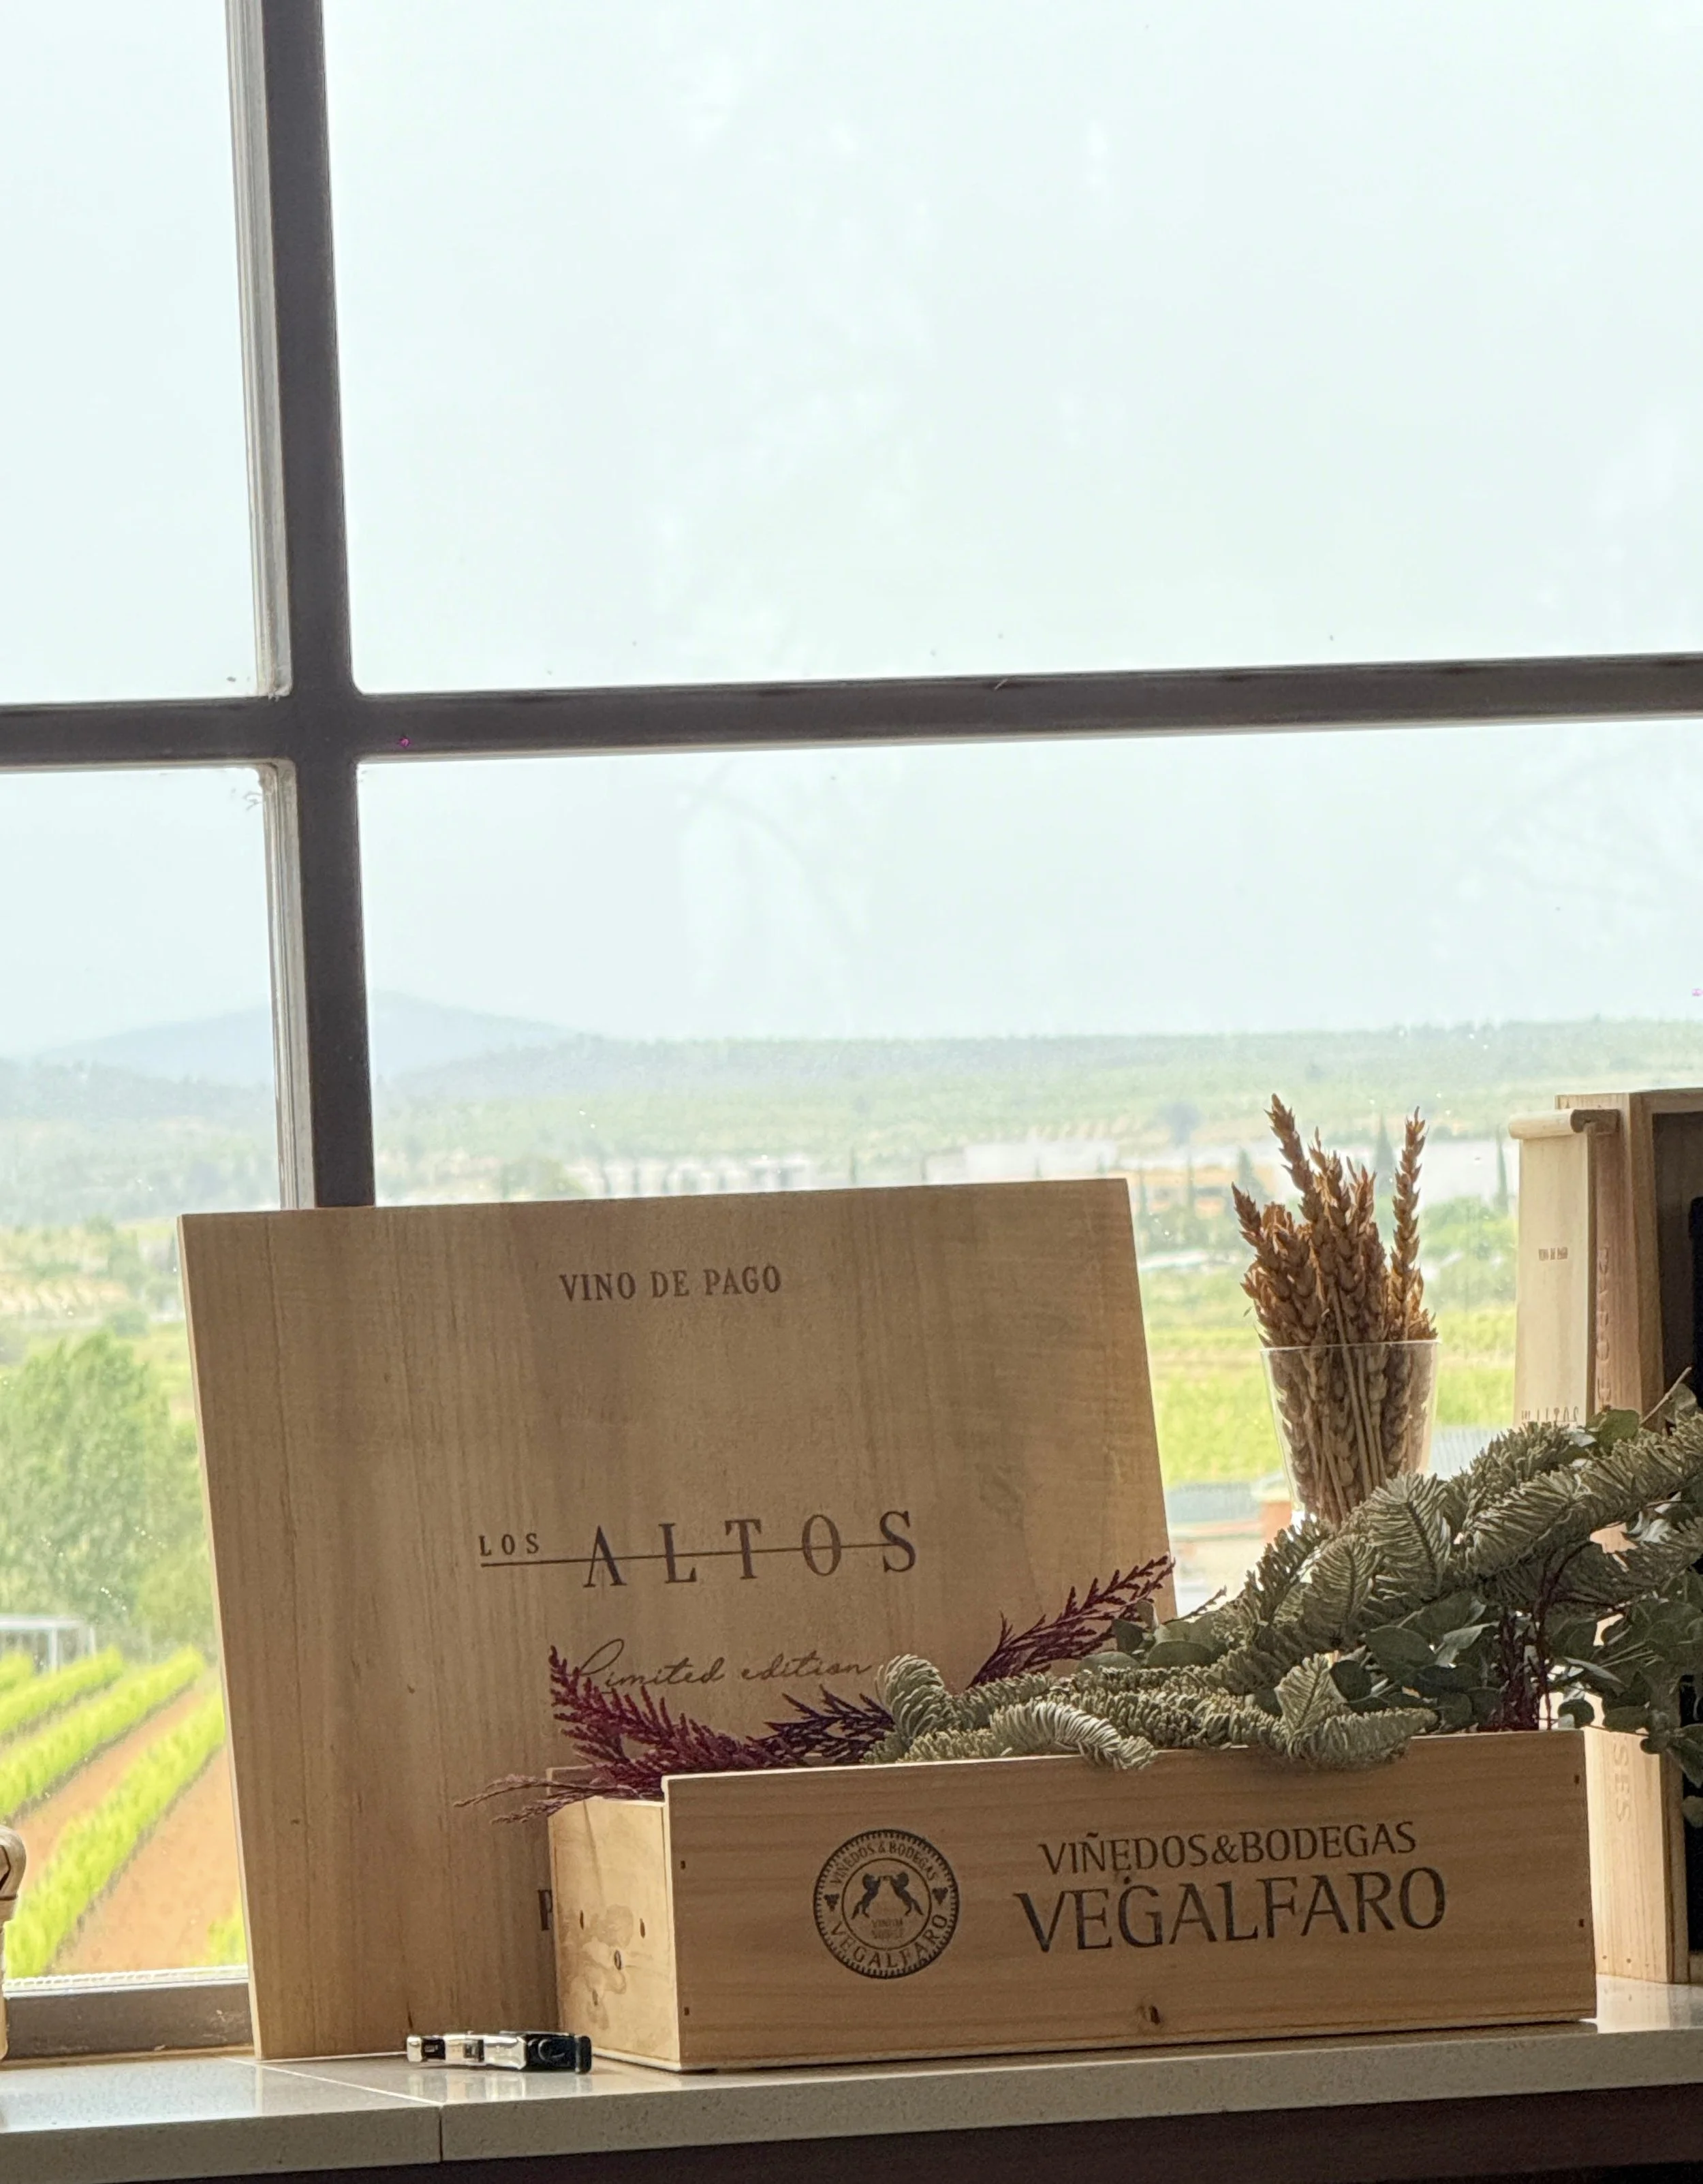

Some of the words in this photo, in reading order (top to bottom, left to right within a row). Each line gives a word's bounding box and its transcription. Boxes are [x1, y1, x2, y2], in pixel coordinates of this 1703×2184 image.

[559, 1271, 636, 1301] VINO
[649, 1270, 689, 1298] DE
[703, 1265, 781, 1295] PAGO
[479, 1533, 540, 1557] LOS
[582, 1510, 916, 1588] ALTOS
[741, 1651, 875, 1681] edition
[877, 1841, 886, 1854] &
[888, 1841, 938, 1882] BODEGAS
[1013, 1867, 1446, 1952] VEGALFARO
[831, 1914, 949, 1969] VEGALFARO
